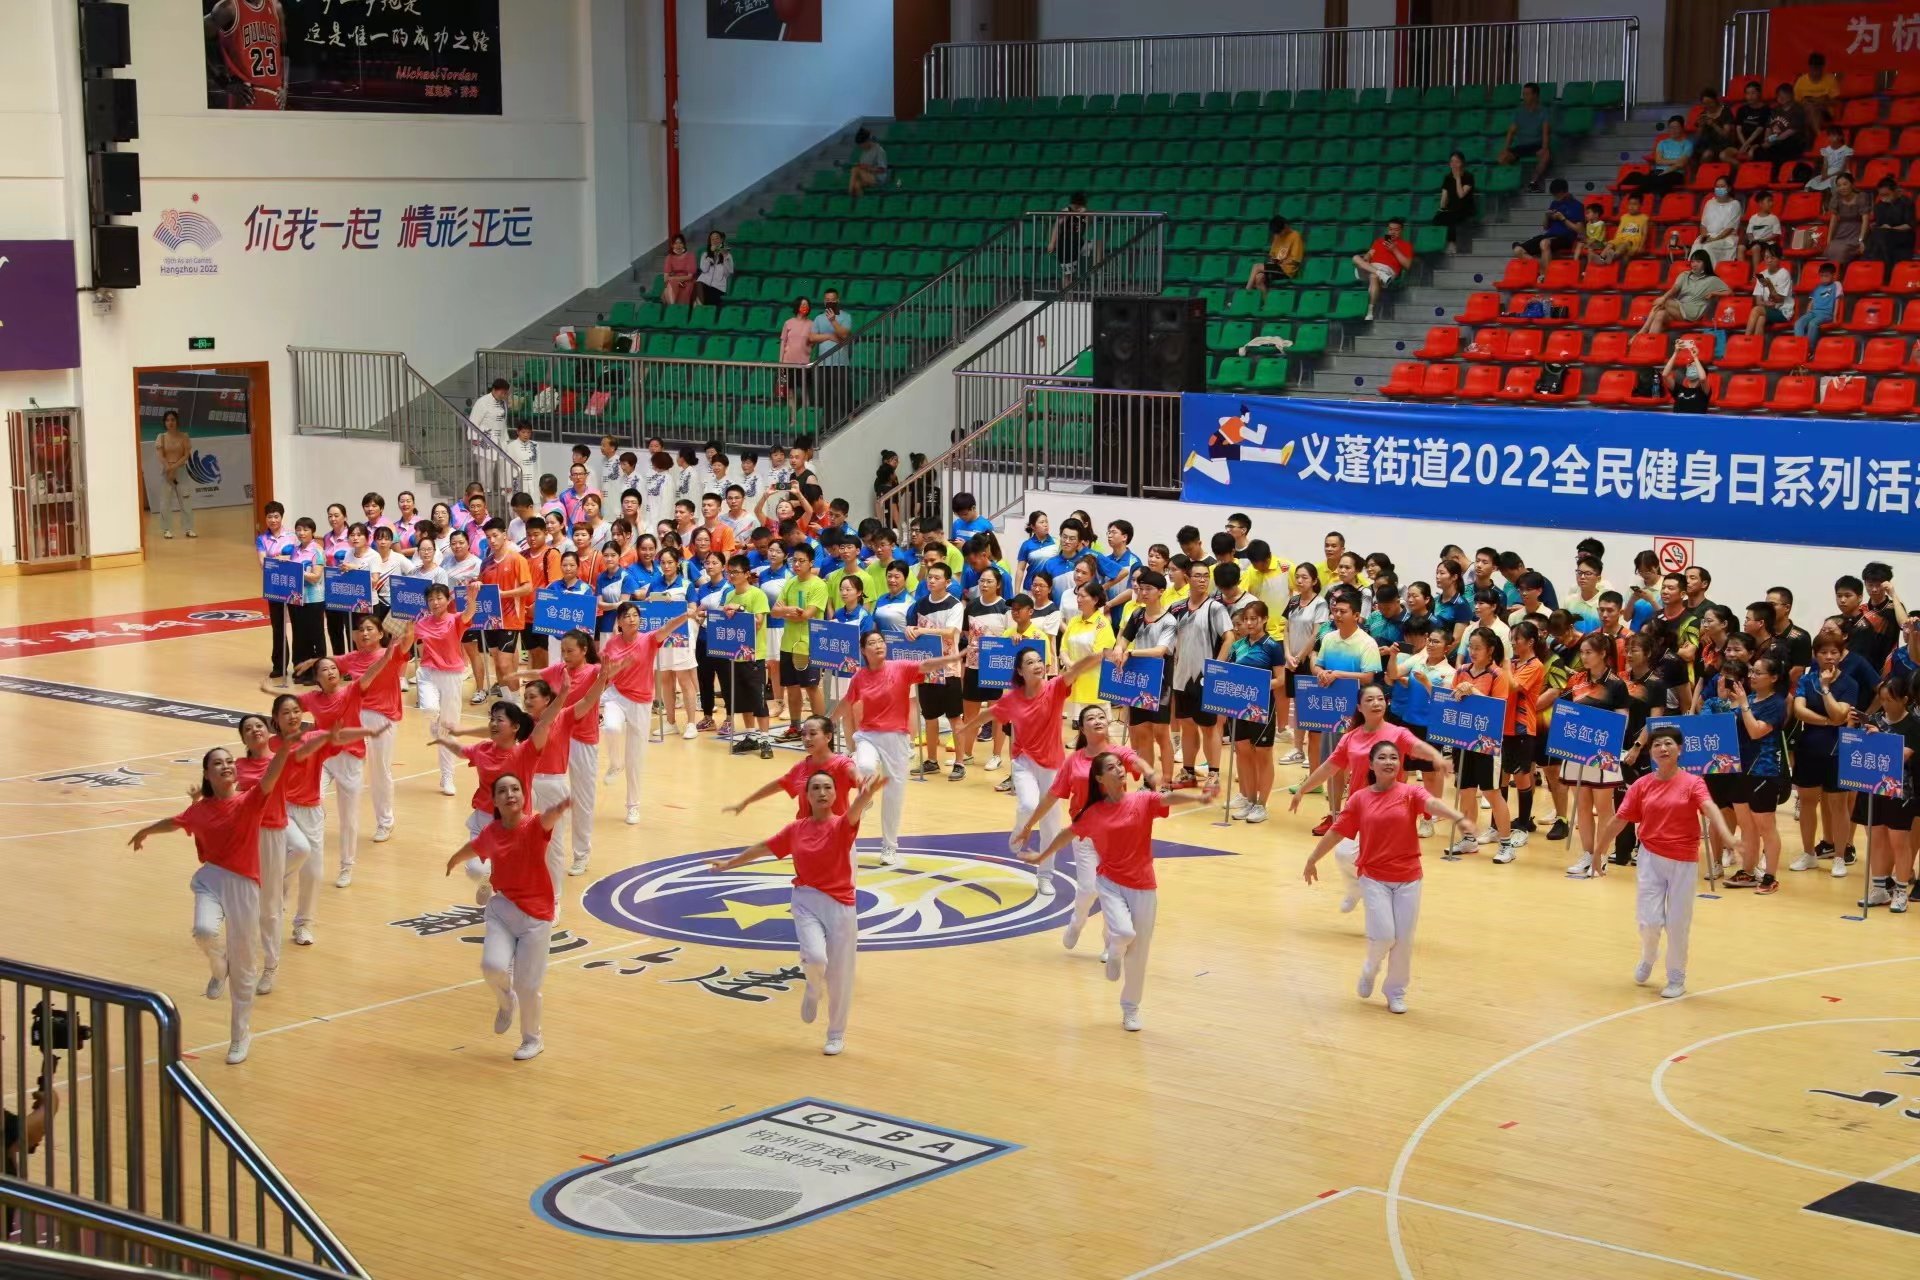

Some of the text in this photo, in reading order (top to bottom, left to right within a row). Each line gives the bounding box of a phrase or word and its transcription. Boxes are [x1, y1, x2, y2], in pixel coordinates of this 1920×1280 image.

[243, 21, 278, 49] BULLS
[304, 21, 489, 52] 这是唯一的成功之路
[1846, 13, 1920, 54] 为杭
[249, 46, 277, 77] 23
[244, 204, 533, 251] 你我一起 精彩亚运
[160, 264, 218, 275] Hangzhou 2022
[1298, 432, 1920, 514] 义蓬街道2022全民健身日系列活
[988, 655, 1017, 670] 后新
[1111, 667, 1149, 689] 新益村
[1307, 695, 1347, 713] 火星村
[1563, 721, 1609, 747] 长红村
[1684, 734, 1720, 753] 浪村
[1850, 750, 1891, 772] 金泉村
[801, 1112, 955, 1154] QTBA
